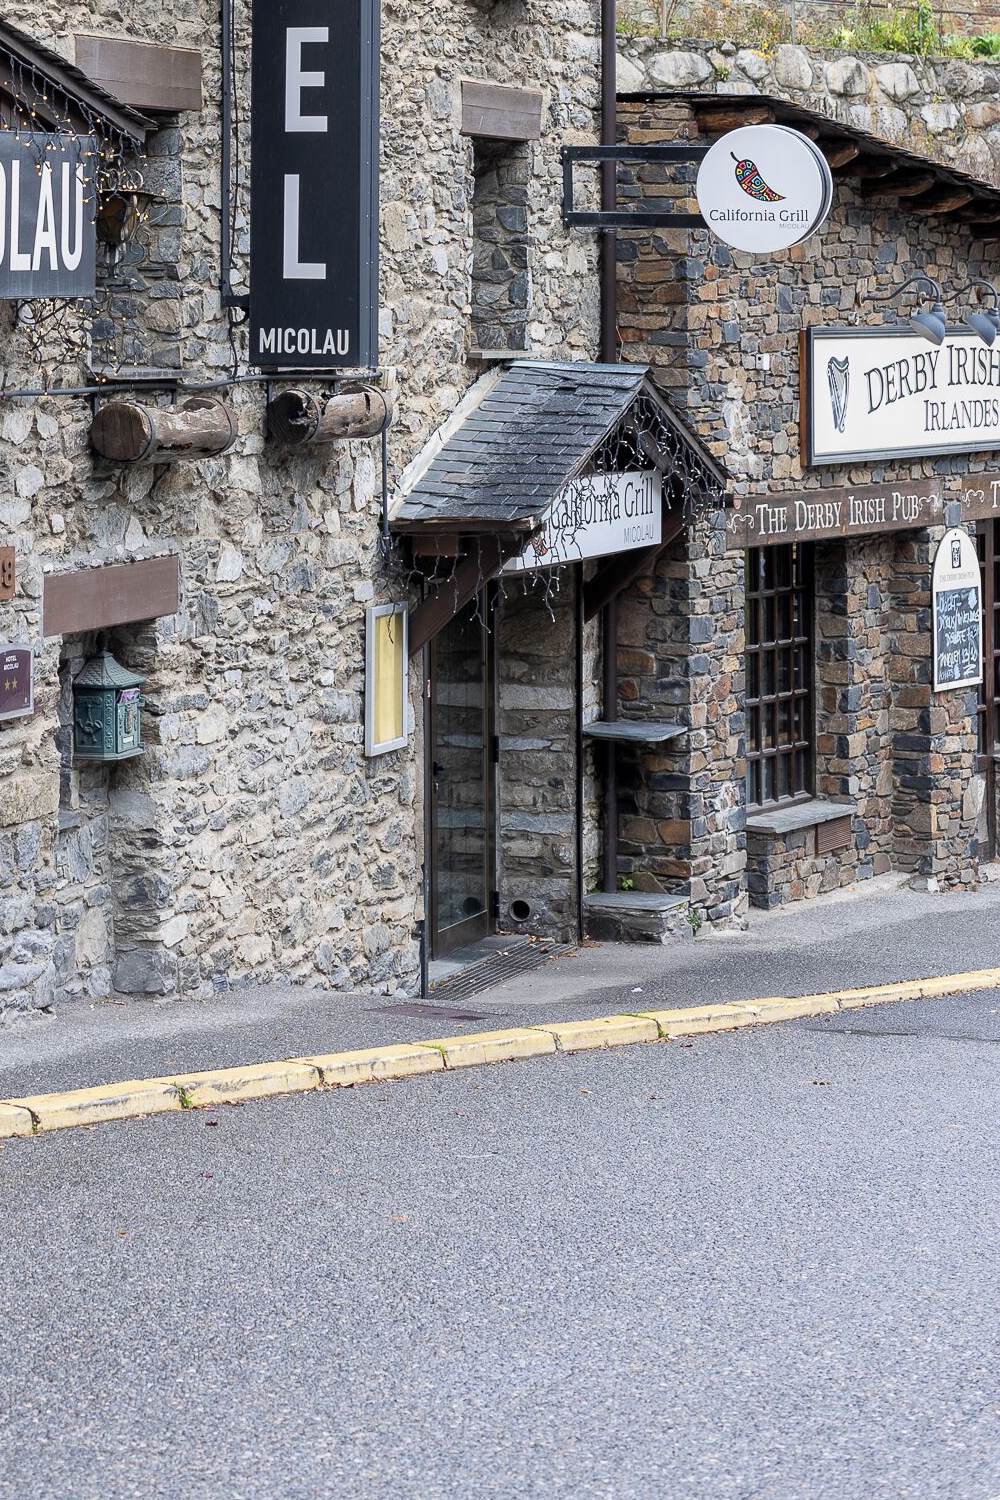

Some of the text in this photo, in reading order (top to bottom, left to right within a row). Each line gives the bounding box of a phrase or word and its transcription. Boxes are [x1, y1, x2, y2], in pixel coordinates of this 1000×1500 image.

[709, 208, 809, 222] California Grill
[778, 222, 810, 230] MICOLAU
[259, 327, 350, 357] MICOLAU
[863, 344, 1000, 415] DERBY IRISH
[924, 397, 1000, 432] IRLANDES
[624, 476, 654, 518] Grill
[755, 491, 920, 536] THE DERBY IRISH PUB
[623, 523, 655, 544] MICOLAU
